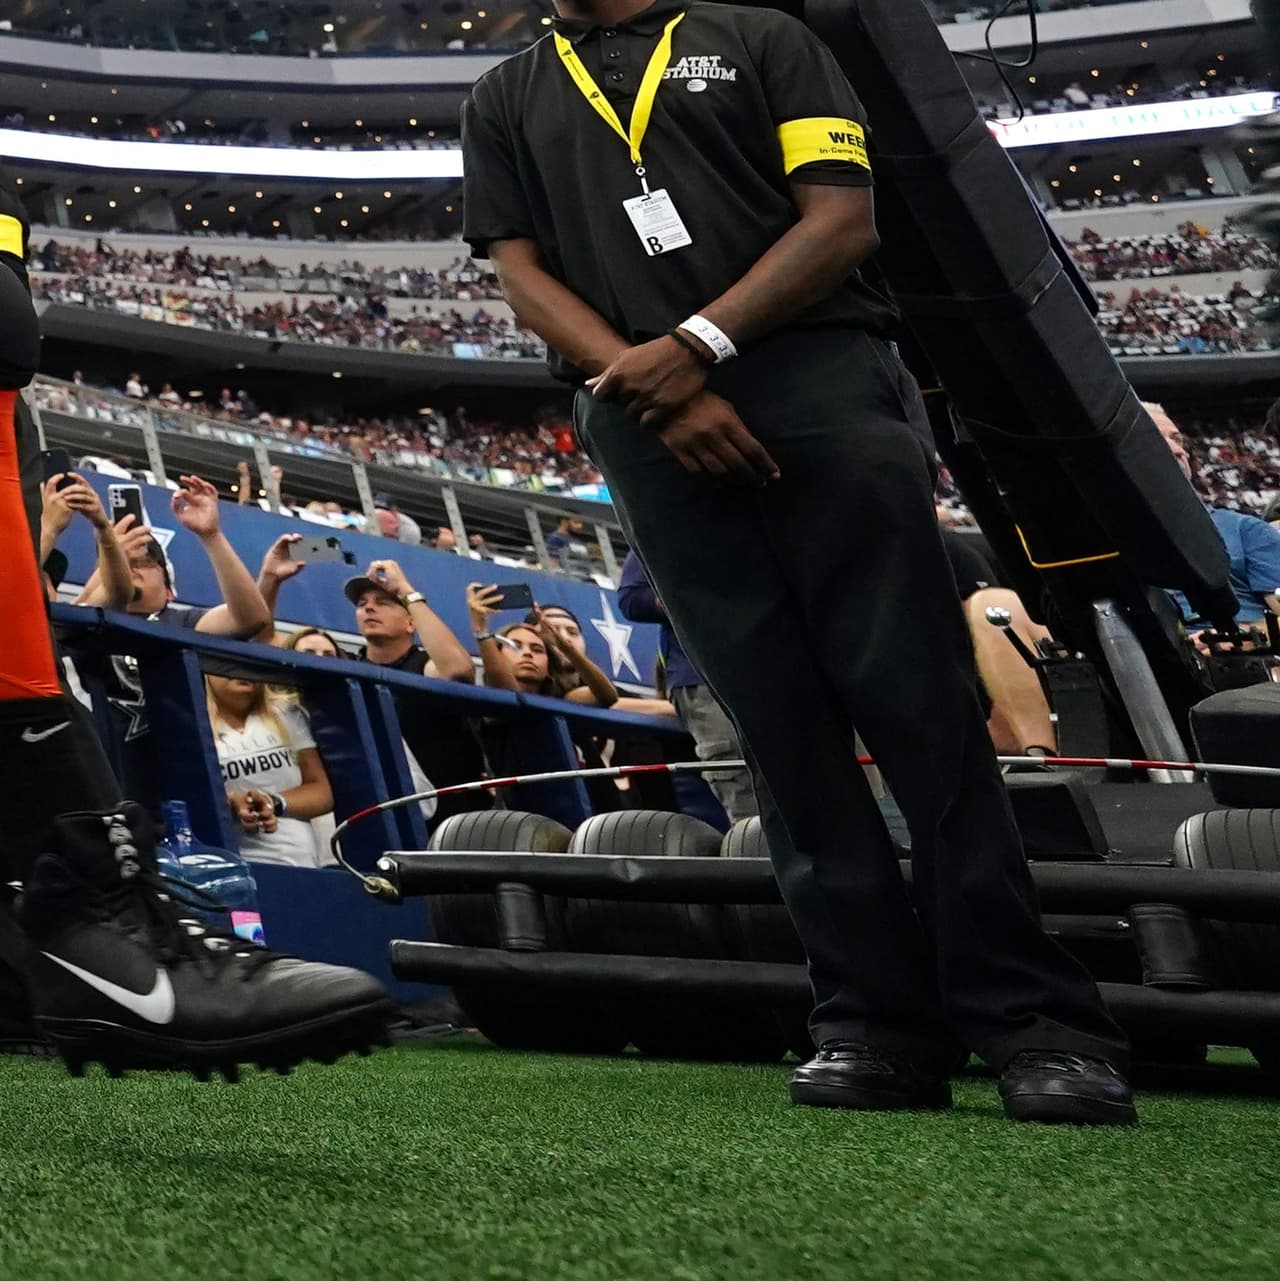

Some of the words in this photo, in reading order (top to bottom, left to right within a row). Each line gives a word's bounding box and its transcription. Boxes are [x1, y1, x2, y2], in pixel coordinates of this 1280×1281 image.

[676, 55, 722, 68] AT&T
[663, 67, 737, 82] STADIUM
[646, 236, 664, 255] B
